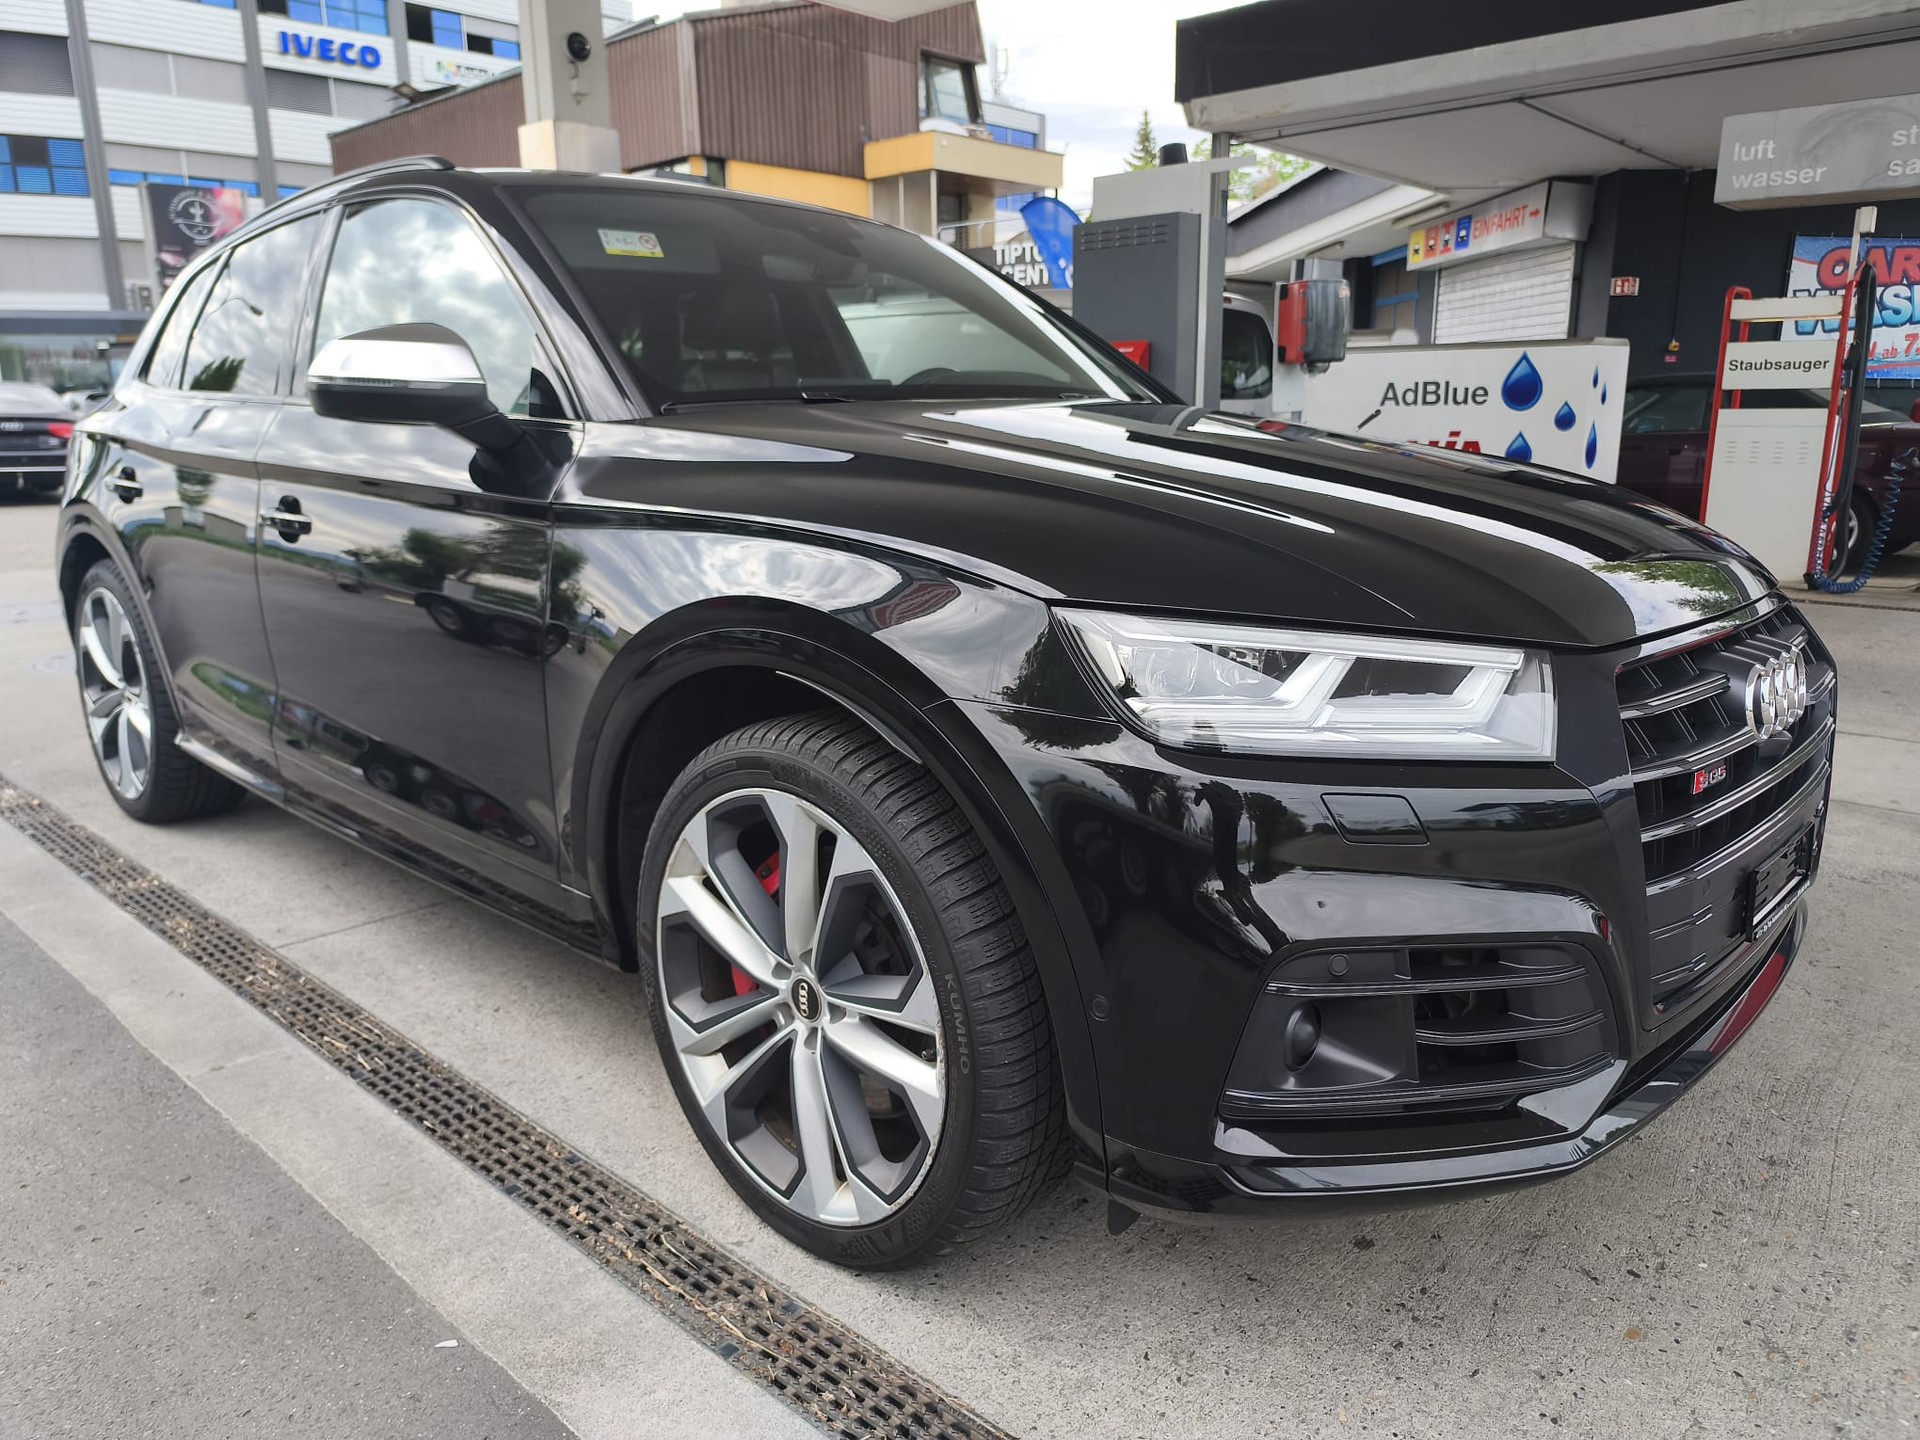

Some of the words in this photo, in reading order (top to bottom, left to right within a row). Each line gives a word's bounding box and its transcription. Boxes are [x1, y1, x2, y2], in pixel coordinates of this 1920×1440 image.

[279, 31, 381, 69] IVECO
[1733, 140, 1776, 161] luft
[1732, 166, 1827, 189] wasser
[1472, 204, 1528, 241] EINFAHRT
[1728, 359, 1830, 373] Staubsauger
[1380, 380, 1489, 406] AdBlue
[944, 972, 970, 1075] KUMHO
